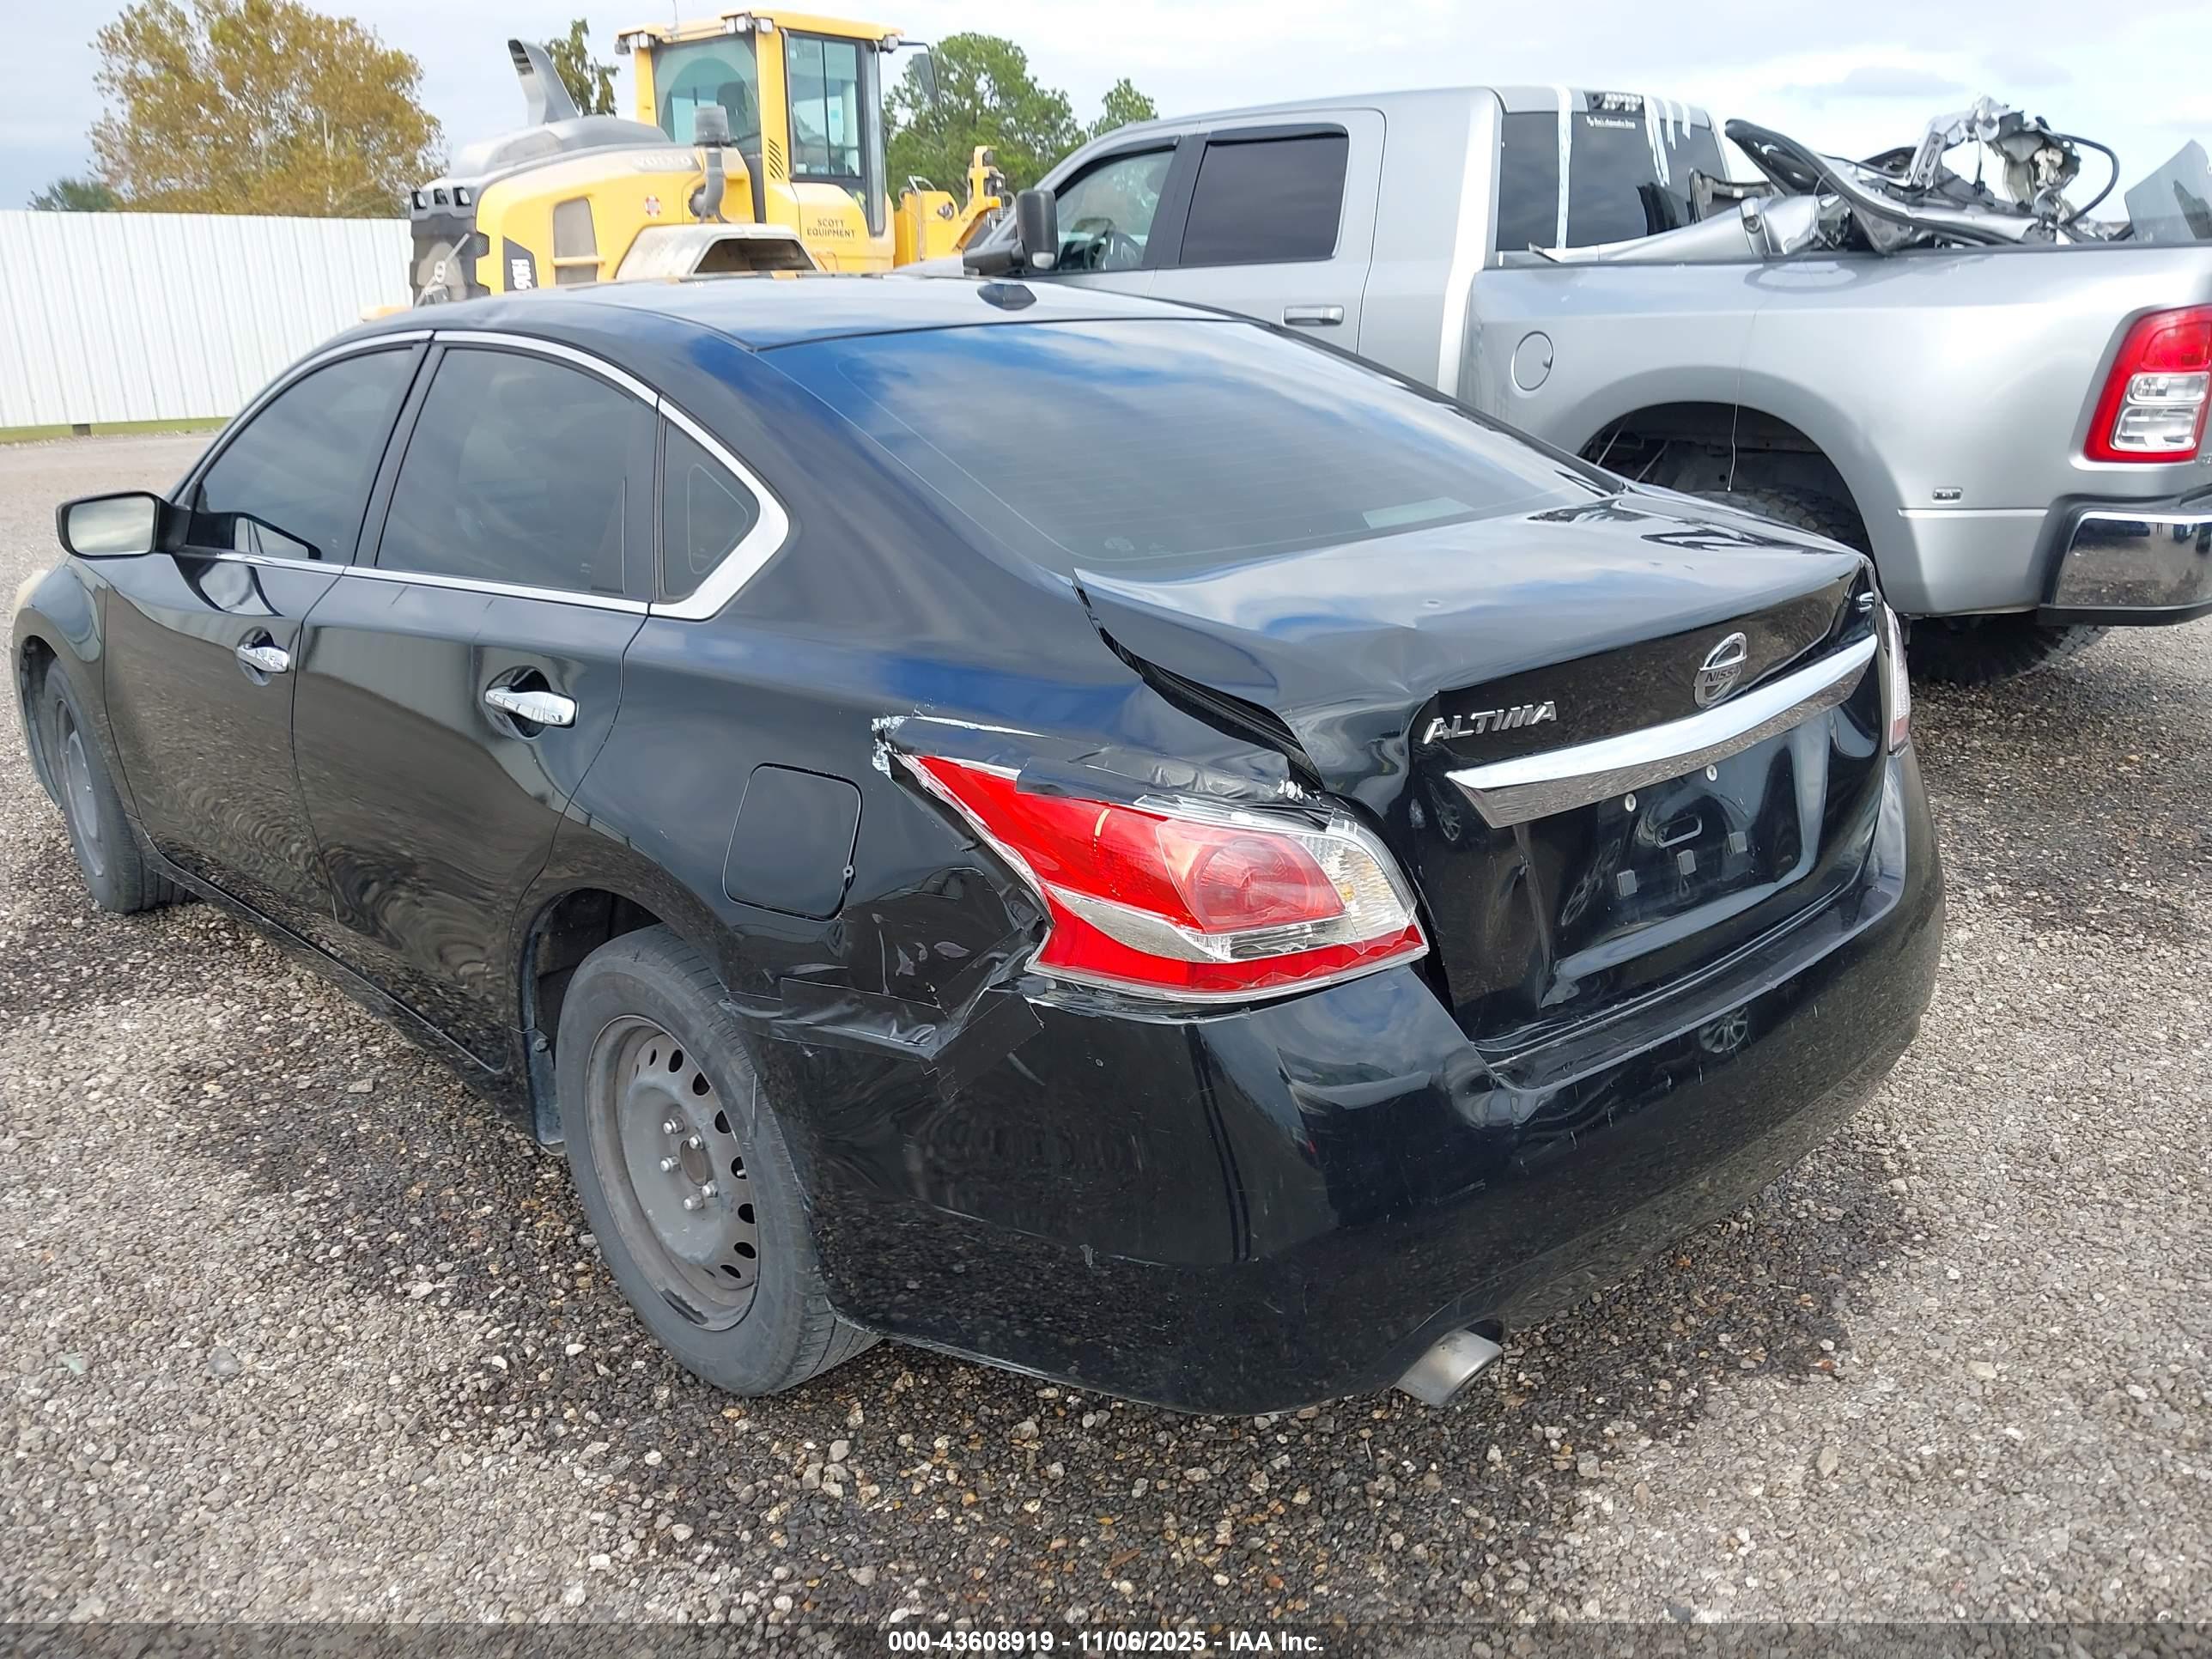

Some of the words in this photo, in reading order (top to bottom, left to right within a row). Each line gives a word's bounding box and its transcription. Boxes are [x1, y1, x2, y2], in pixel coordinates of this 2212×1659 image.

[817, 218, 845, 228] SCOTT
[806, 228, 856, 239] EQUIPMENT
[1858, 592, 1874, 612] S
[1422, 701, 1558, 744] ALTIMA
